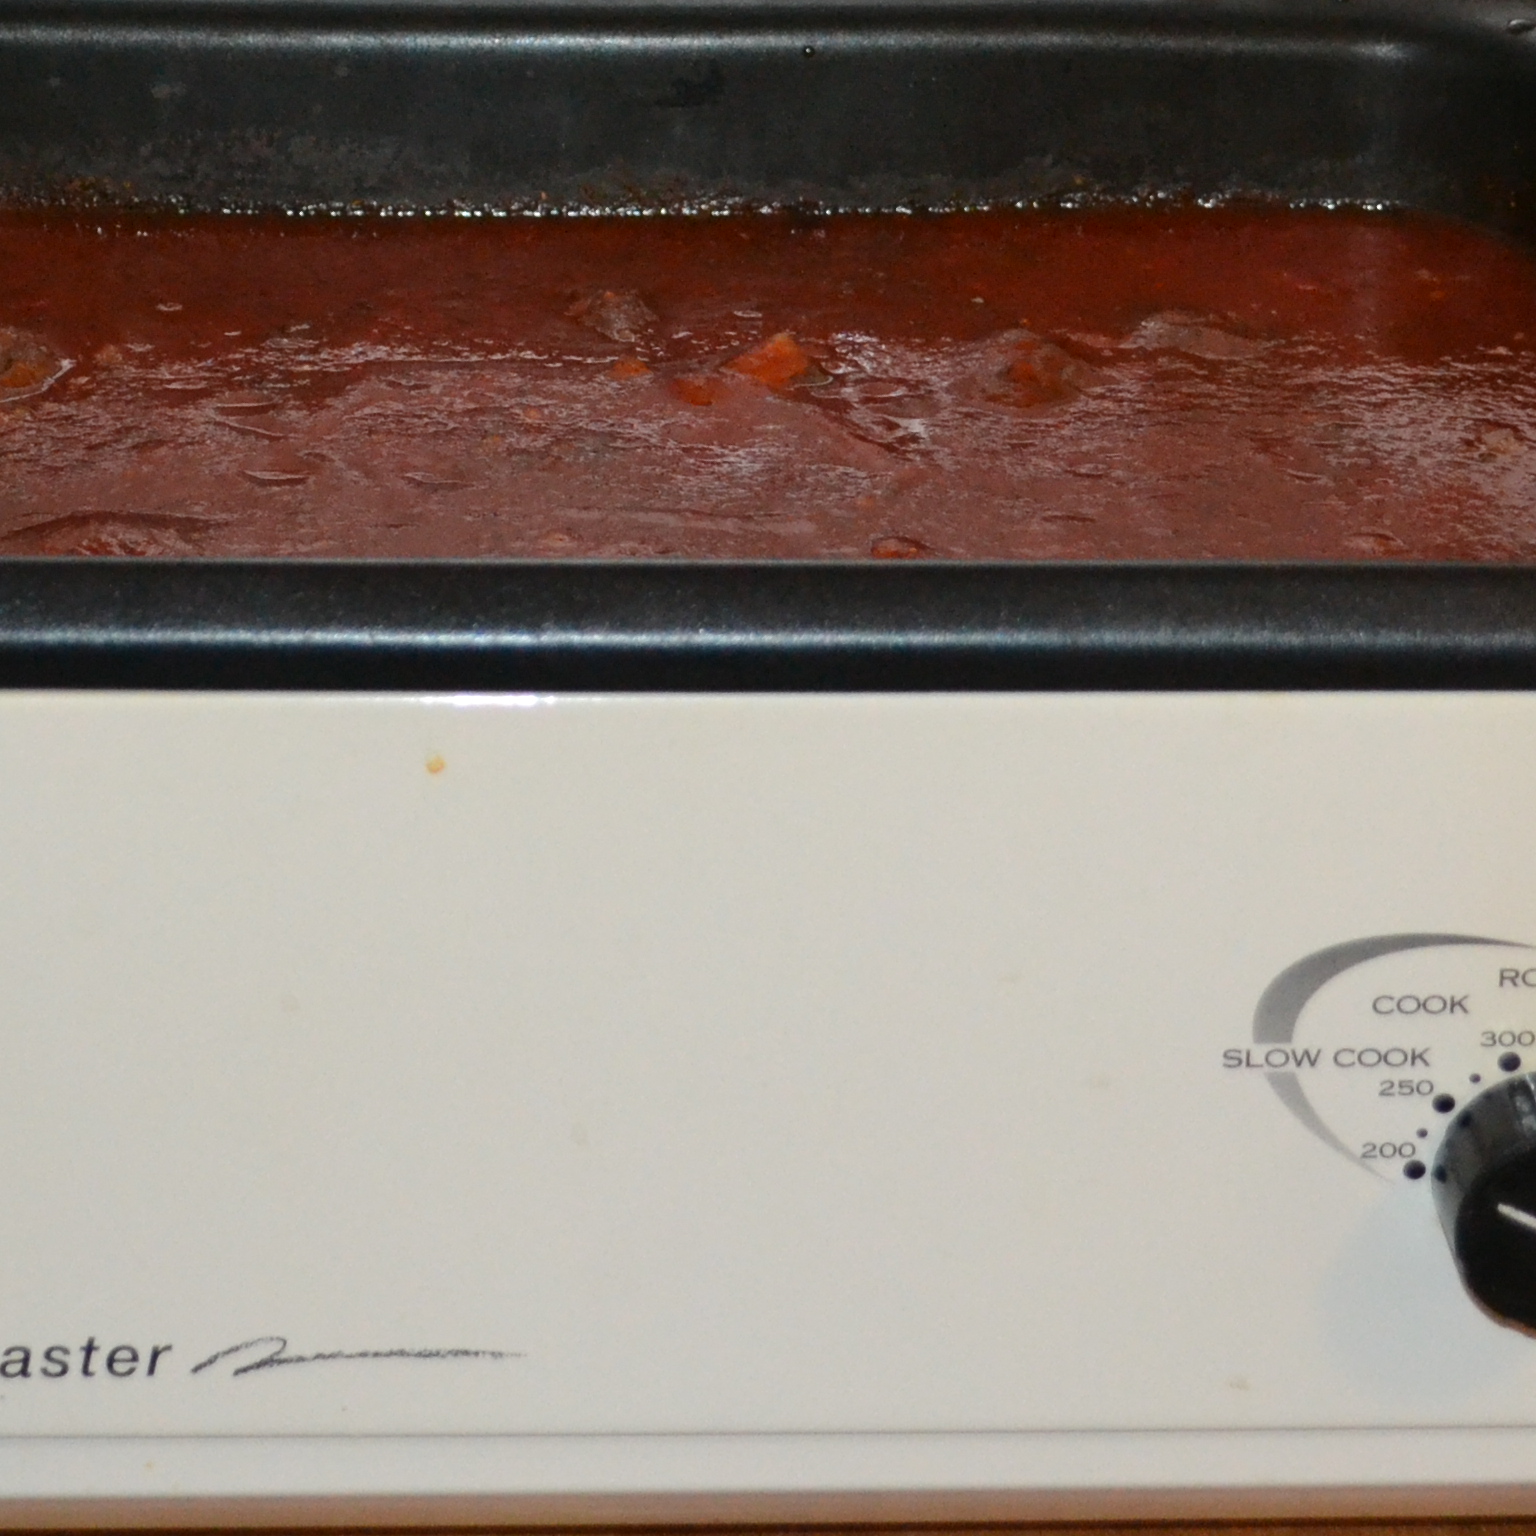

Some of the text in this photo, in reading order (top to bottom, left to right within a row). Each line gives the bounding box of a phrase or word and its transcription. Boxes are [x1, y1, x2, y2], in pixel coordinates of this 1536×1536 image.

[1371, 994, 1470, 1015] COOK
[1479, 1029, 1536, 1048] 300
[1221, 1047, 1432, 1069] SLOW COOK
[1377, 1079, 1435, 1097] 250
[1360, 1141, 1417, 1159] 200
